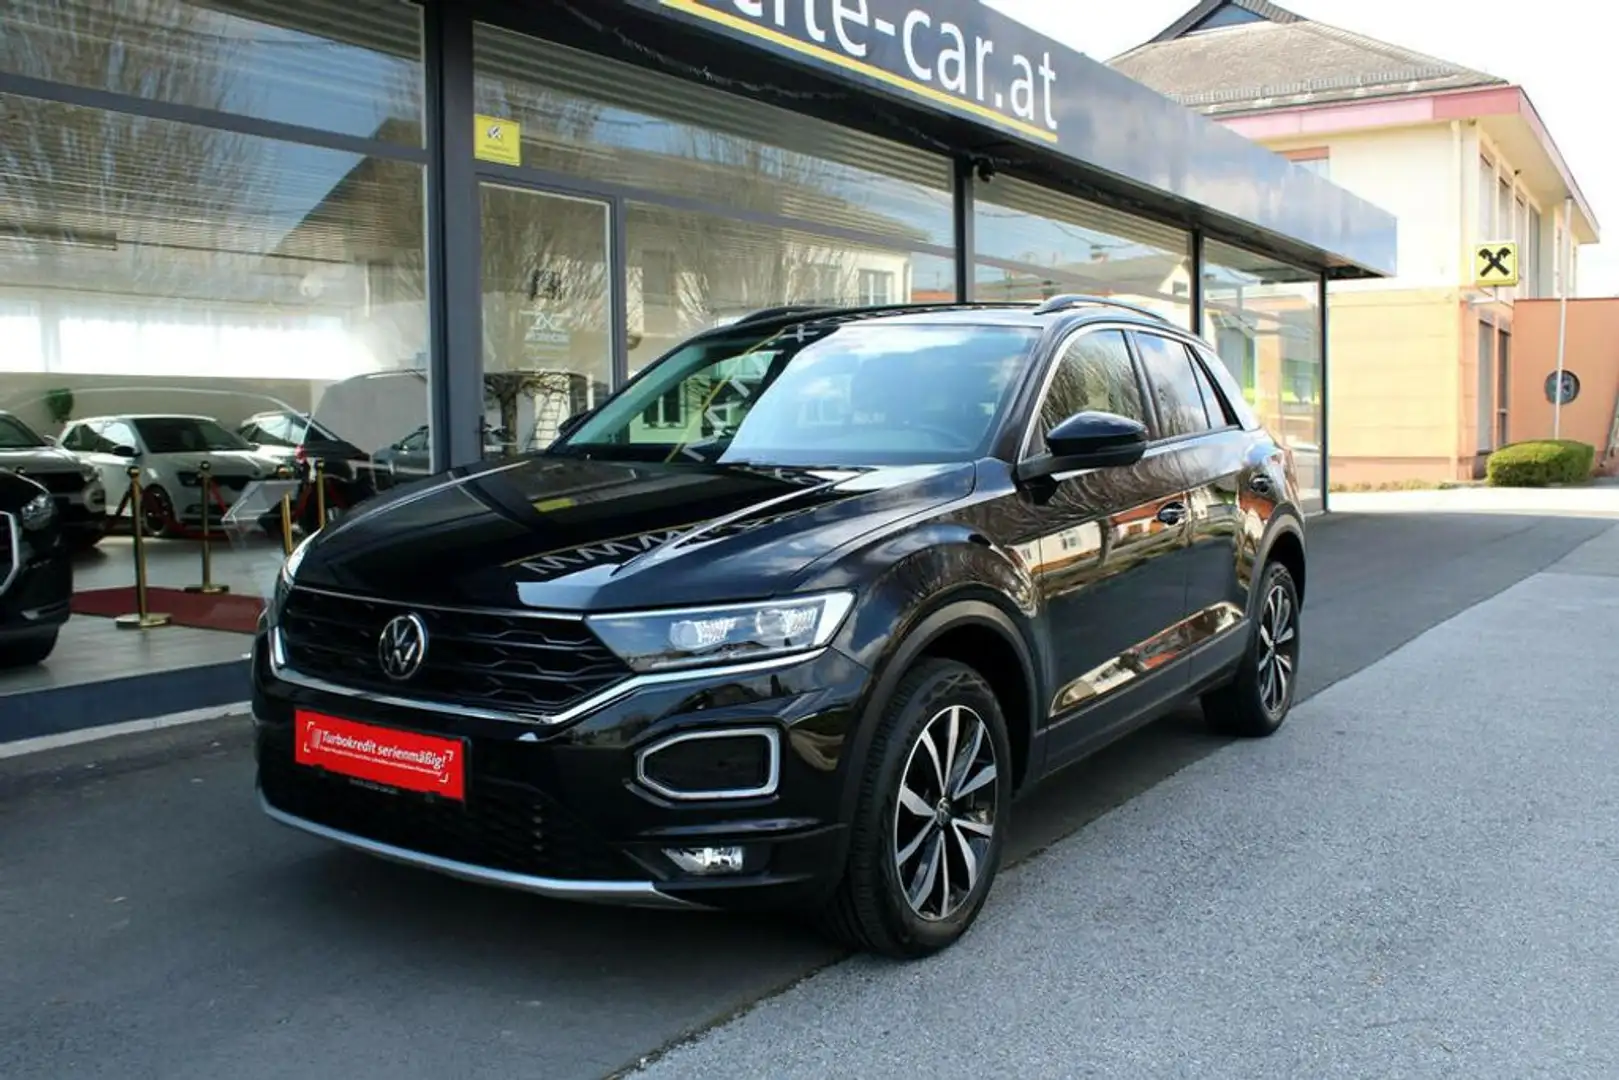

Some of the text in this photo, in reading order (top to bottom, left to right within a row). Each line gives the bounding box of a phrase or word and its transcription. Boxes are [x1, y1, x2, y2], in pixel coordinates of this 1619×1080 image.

[733, 0, 1057, 129] e-car.at
[322, 730, 376, 754] Turbokredit
[377, 745, 446, 770] serienmäßig!
